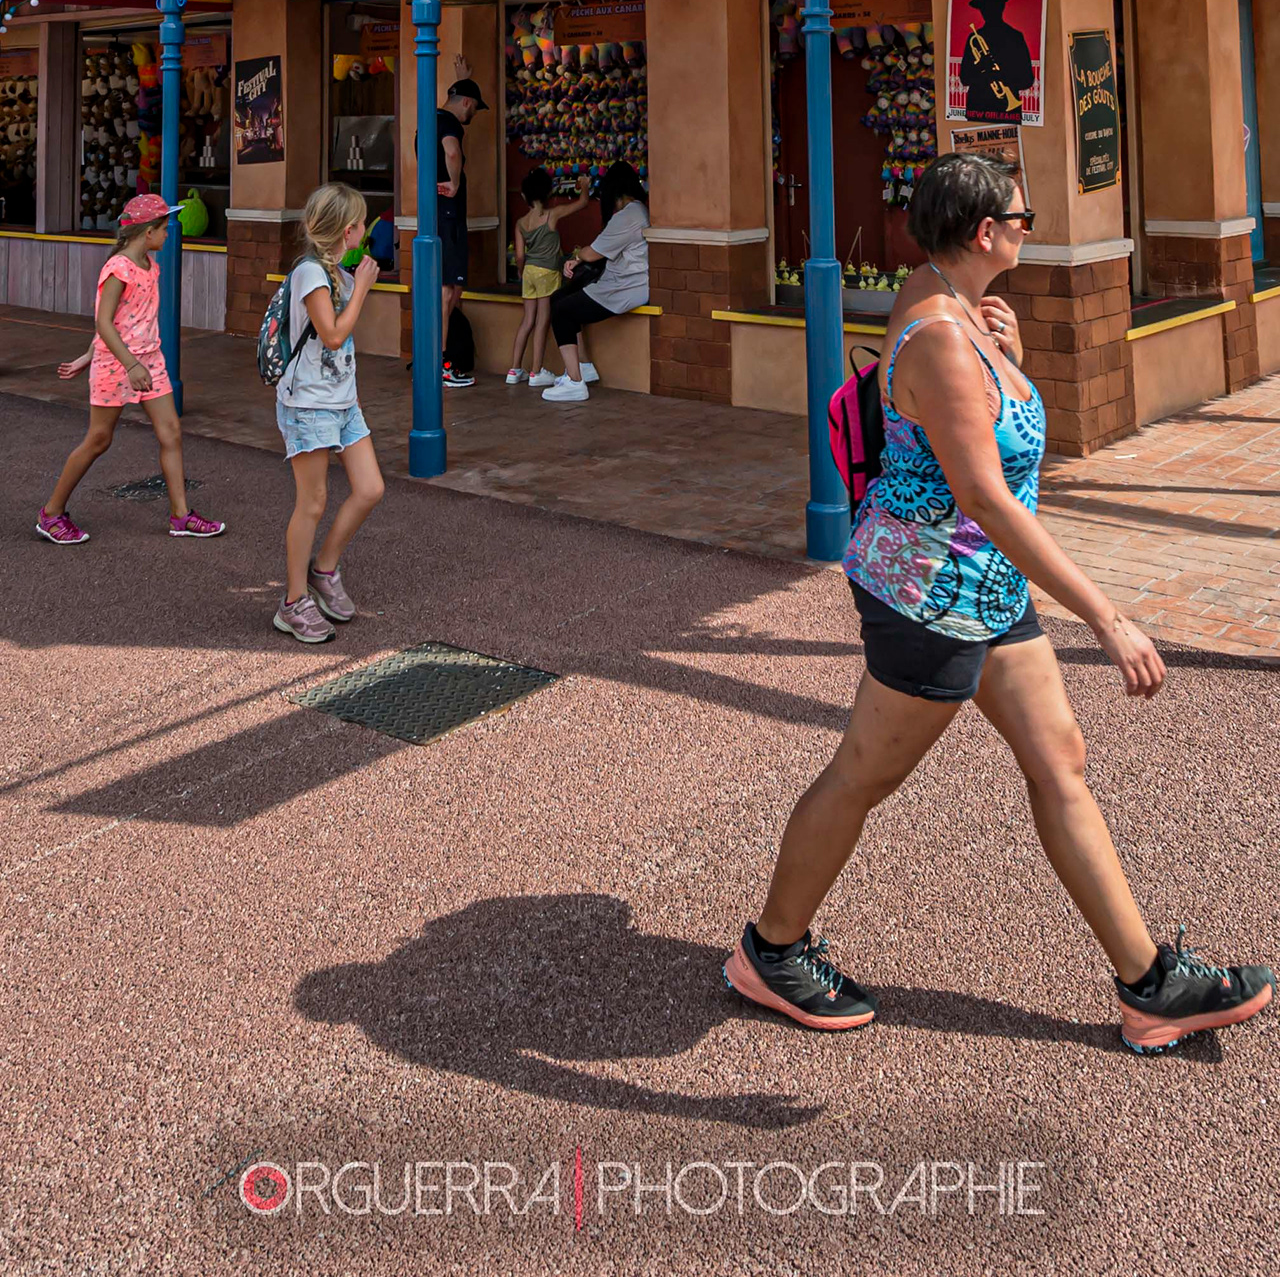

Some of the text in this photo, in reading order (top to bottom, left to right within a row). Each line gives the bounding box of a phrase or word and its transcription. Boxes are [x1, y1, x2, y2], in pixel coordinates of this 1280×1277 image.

[596, 5, 613, 15] AUX
[615, 3, 645, 14] CANAR
[237, 60, 277, 96] FESTIVAL
[1074, 60, 1112, 88] LA BOUCHE
[248, 78, 268, 101] CITY
[948, 108, 1040, 122] JUNE NEW ORLEANS JULY
[1079, 92, 1092, 116] DES
